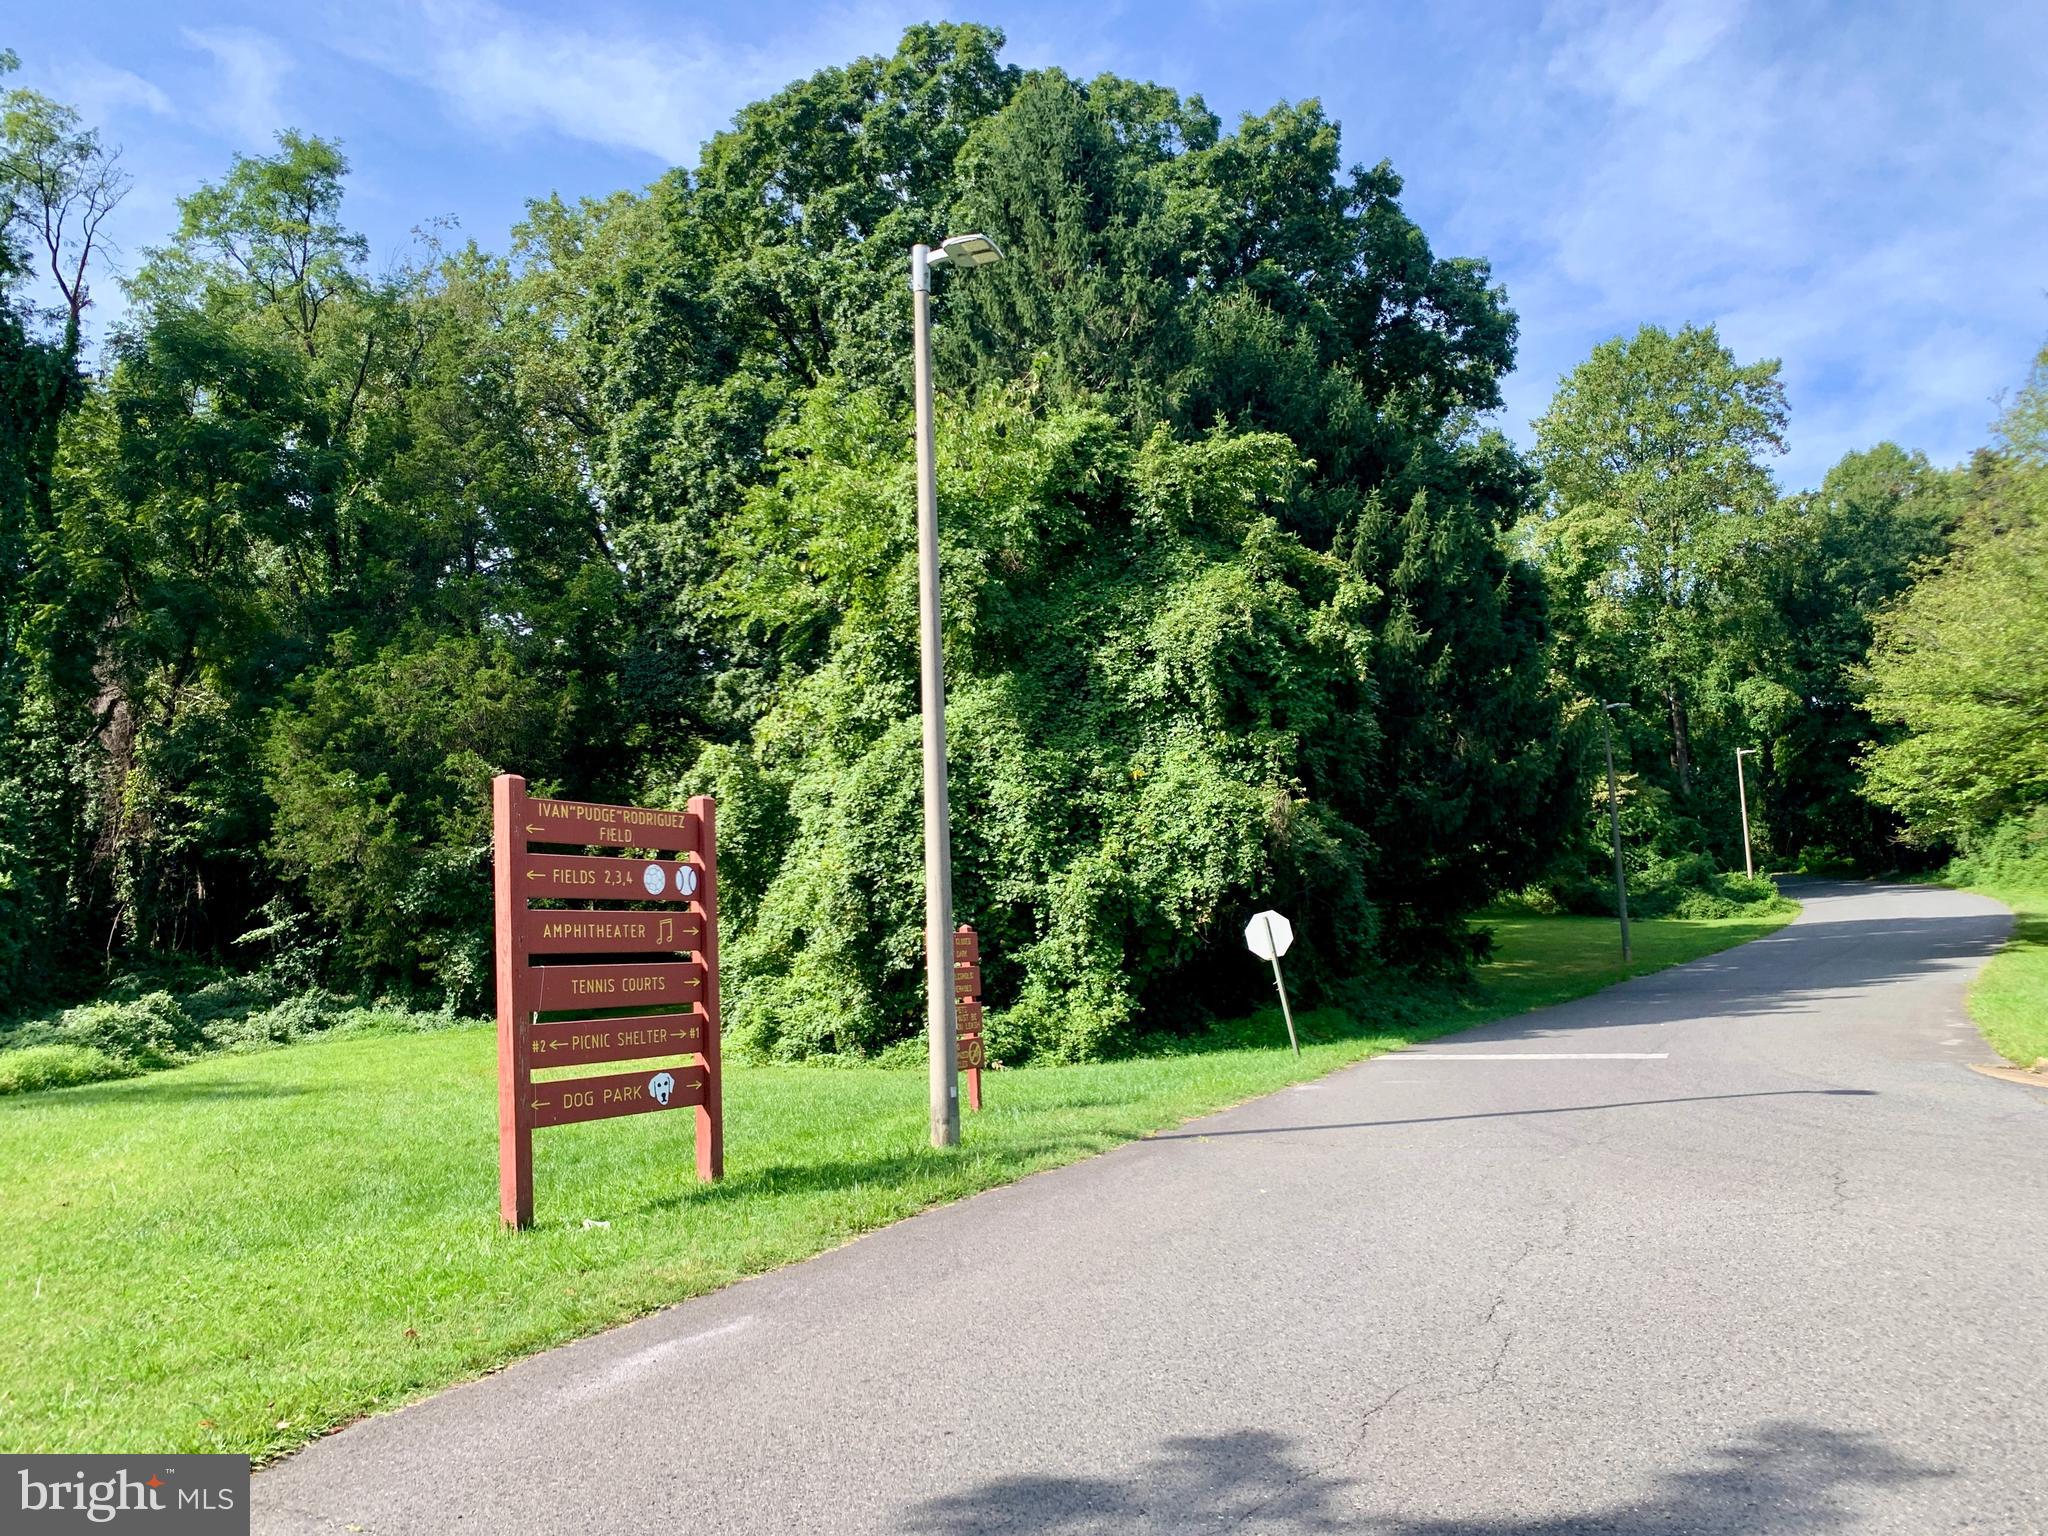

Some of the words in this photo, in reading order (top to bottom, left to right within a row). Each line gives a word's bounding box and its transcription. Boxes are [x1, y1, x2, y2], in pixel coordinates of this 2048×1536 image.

[538, 802, 569, 819] IVAN
[623, 810, 686, 829] RODRIGUEZ
[599, 827, 633, 843] FIELD
[553, 869, 596, 885] FIELDS
[604, 870, 633, 885] 2,3,4
[543, 923, 646, 938] AMPHITHEATER
[572, 978, 615, 994] TENNIS
[622, 976, 666, 992] COURTS
[532, 1040, 547, 1052] #2
[572, 1033, 611, 1050] PICNIC
[617, 1028, 668, 1046] SHELTER
[689, 1027, 700, 1039] #1
[563, 1090, 594, 1109] DOG
[603, 1085, 642, 1103] PARK
